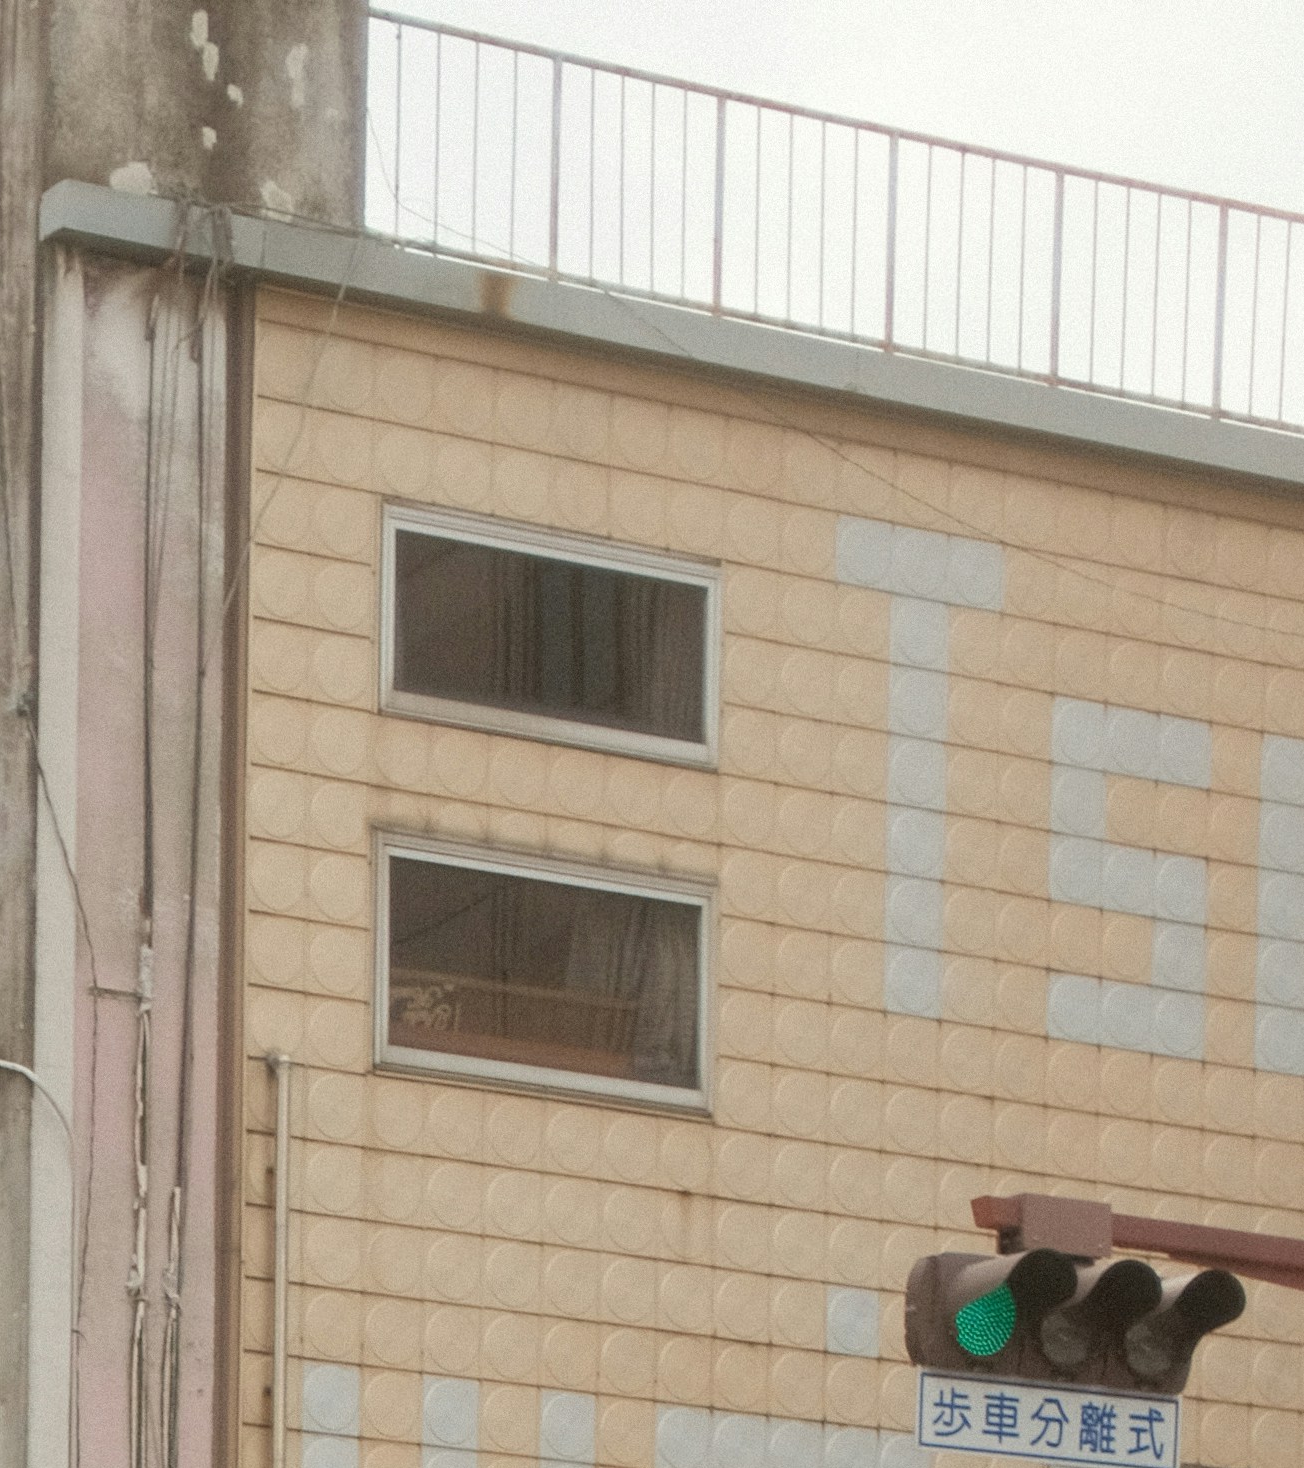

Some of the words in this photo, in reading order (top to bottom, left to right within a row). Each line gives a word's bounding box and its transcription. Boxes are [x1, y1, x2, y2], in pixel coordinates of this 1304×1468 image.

[932, 1387, 1165, 1461] 歩車分離式
